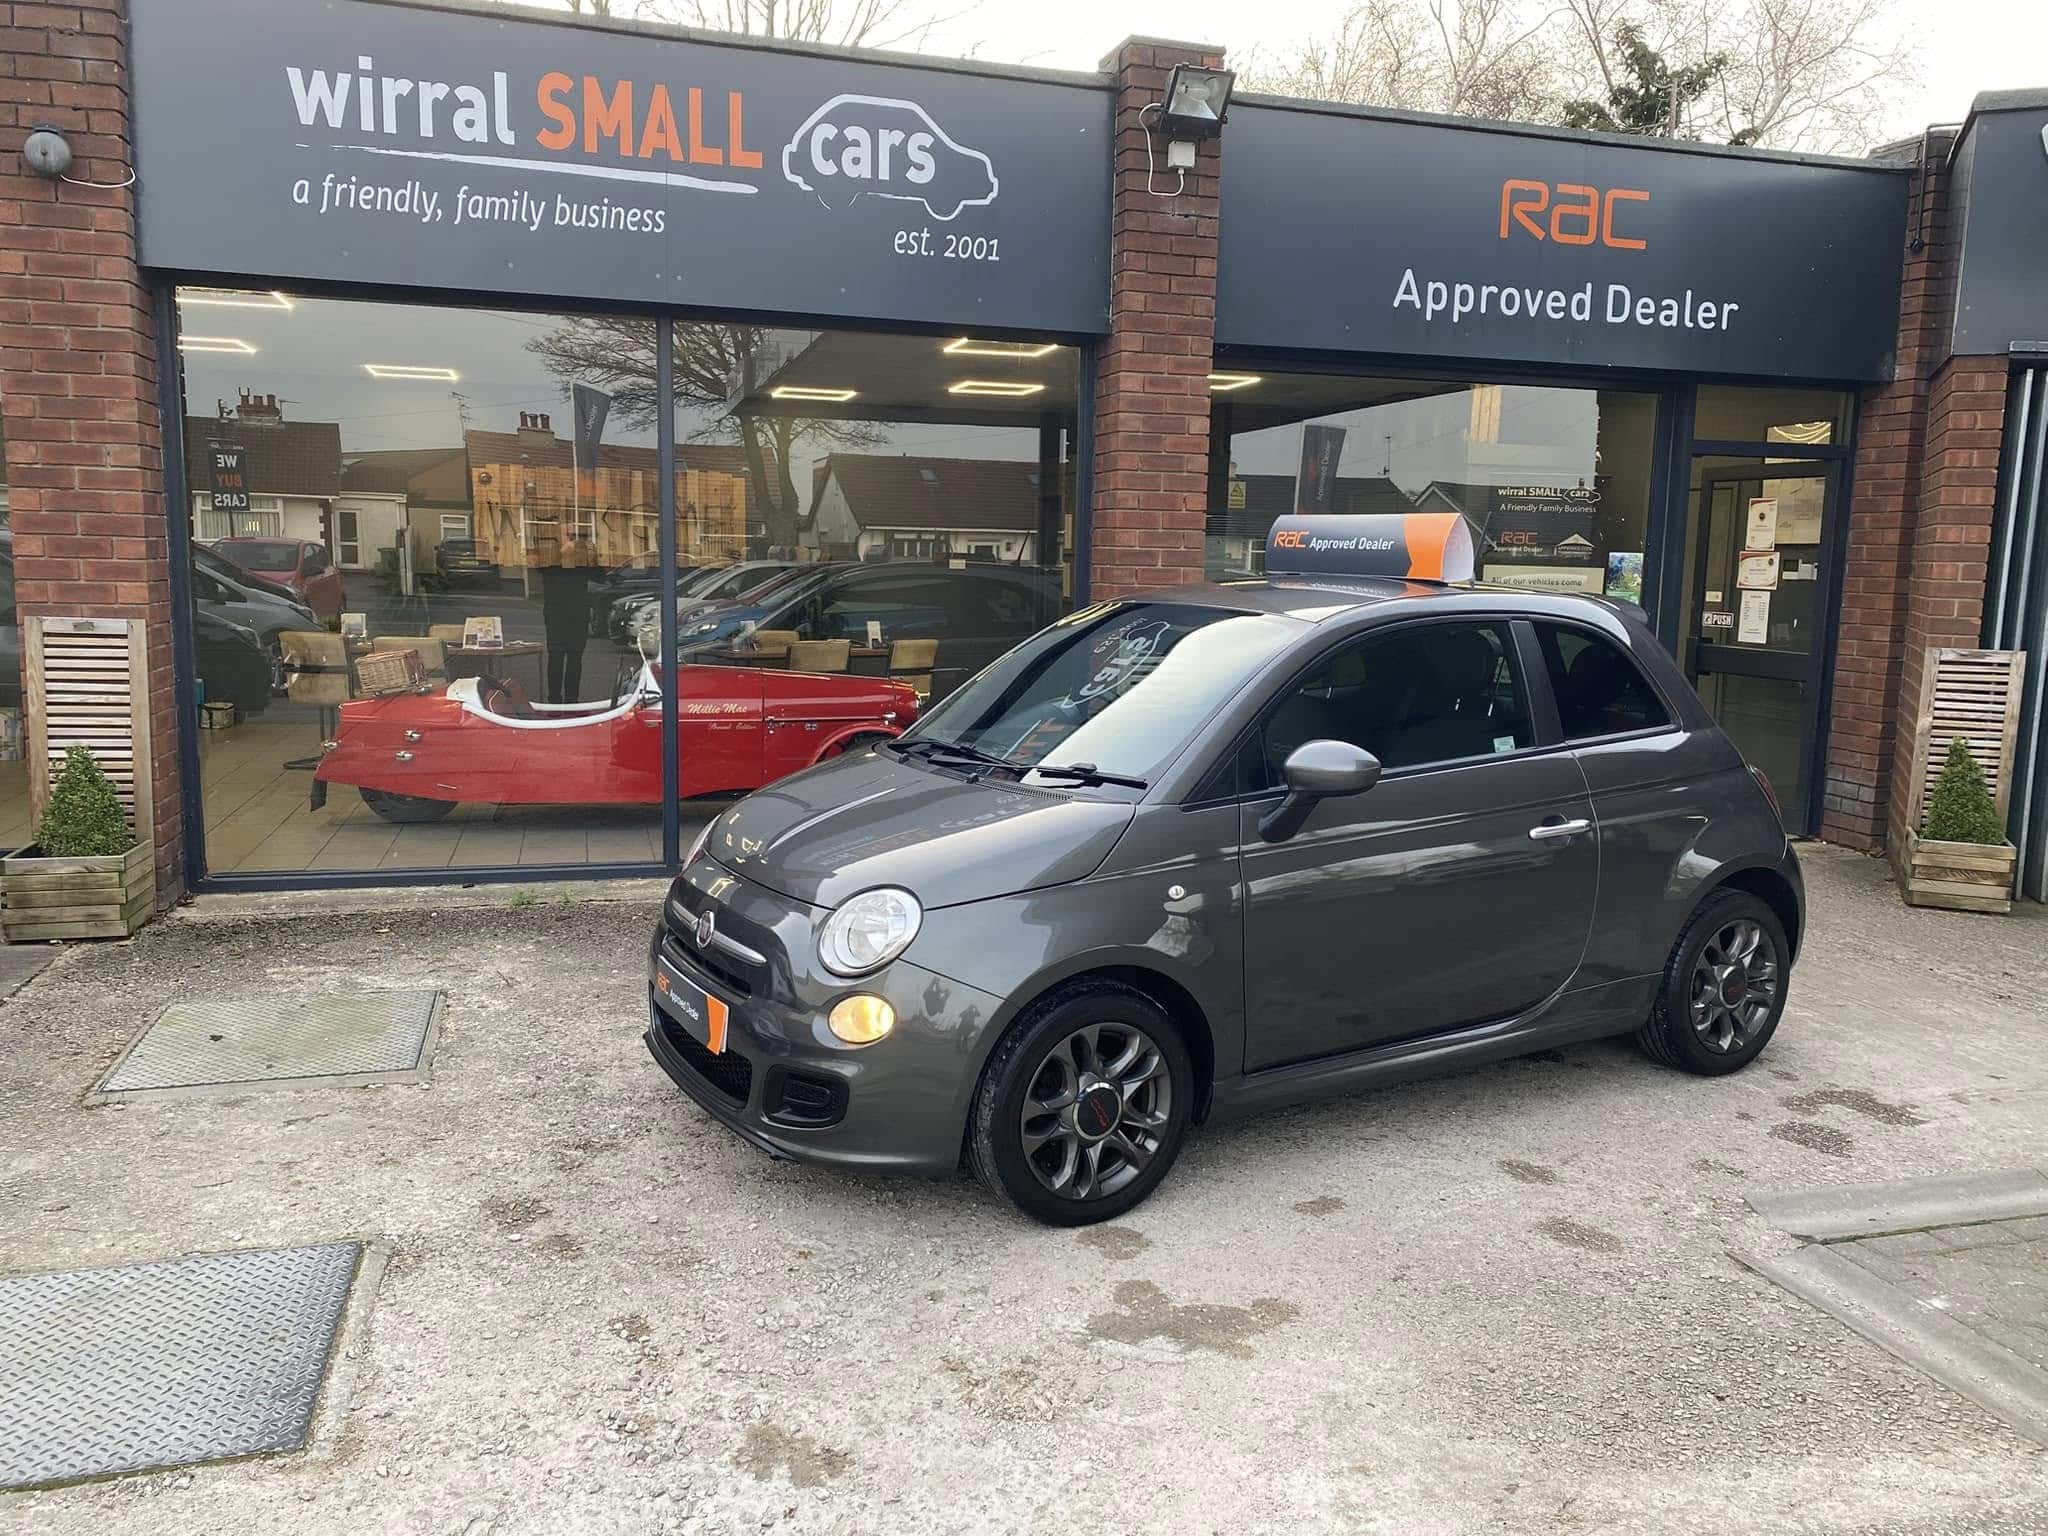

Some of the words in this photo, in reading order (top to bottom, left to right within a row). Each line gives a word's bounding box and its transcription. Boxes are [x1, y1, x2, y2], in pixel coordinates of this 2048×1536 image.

[286, 55, 515, 146] wirral
[536, 71, 763, 169] SMALL
[810, 122, 936, 184] cars
[292, 178, 310, 205] a
[319, 173, 443, 223] friendly,
[453, 185, 546, 231] family
[554, 193, 666, 233] business
[893, 227, 936, 257] est.
[943, 234, 1000, 261] 2001
[1392, 267, 1593, 324] Approved
[1605, 283, 1740, 331] Dealer
[1498, 486, 1527, 496] wirral
[1528, 487, 1563, 497] SMALL
[1569, 490, 1590, 498] cars
[1500, 503, 1506, 511] A
[1507, 503, 1538, 514] Friendly
[1539, 504, 1564, 514] Family
[1564, 504, 1597, 513] Business
[1308, 536, 1356, 552] Approved
[1358, 537, 1395, 551] Dealer
[1528, 577, 1559, 586] vehicles
[1712, 613, 1732, 626] PUSH
